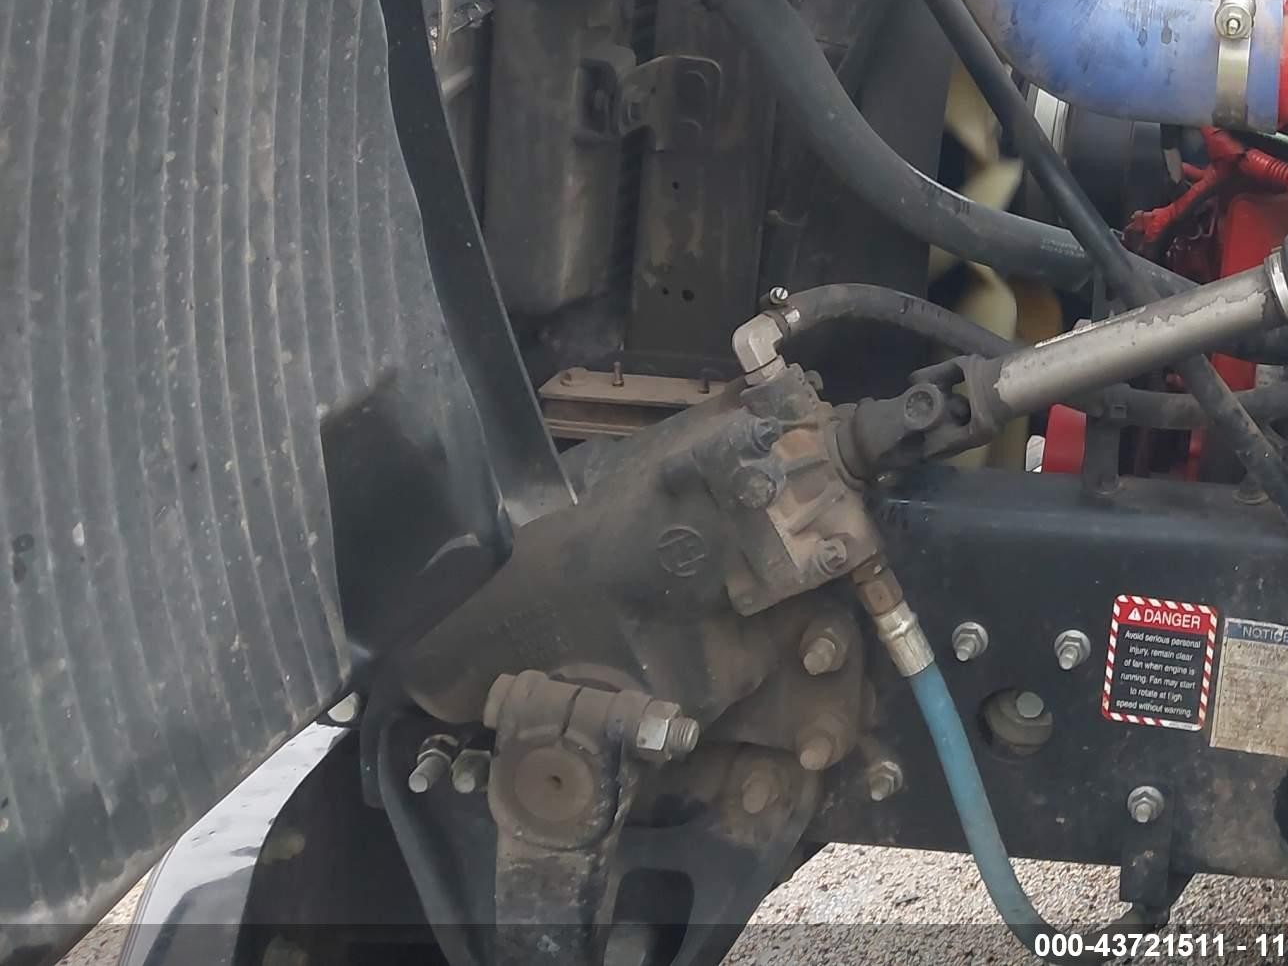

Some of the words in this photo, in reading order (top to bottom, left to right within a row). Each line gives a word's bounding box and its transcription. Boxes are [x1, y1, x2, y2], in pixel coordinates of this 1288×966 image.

[1143, 609, 1201, 629] DANGER
[1125, 630, 1144, 641] Avoid
[1145, 634, 1170, 644] serious
[1171, 637, 1201, 649] personal
[1129, 645, 1149, 657] injury,
[1151, 649, 1175, 659] remain
[1175, 651, 1193, 662] clear
[1124, 658, 1132, 667] of
[1132, 659, 1143, 669] fan
[1144, 661, 1163, 672] when
[1164, 665, 1188, 675] engine
[1188, 667, 1195, 676] is
[1149, 675, 1162, 685] Fan
[1163, 679, 1179, 689] may
[1179, 680, 1196, 690] start
[1129, 686, 1137, 696] to
[1138, 688, 1158, 698] rotate
[1159, 690, 1167, 699] at
[1115, 699, 1138, 709] speed
[1138, 702, 1163, 713] without
